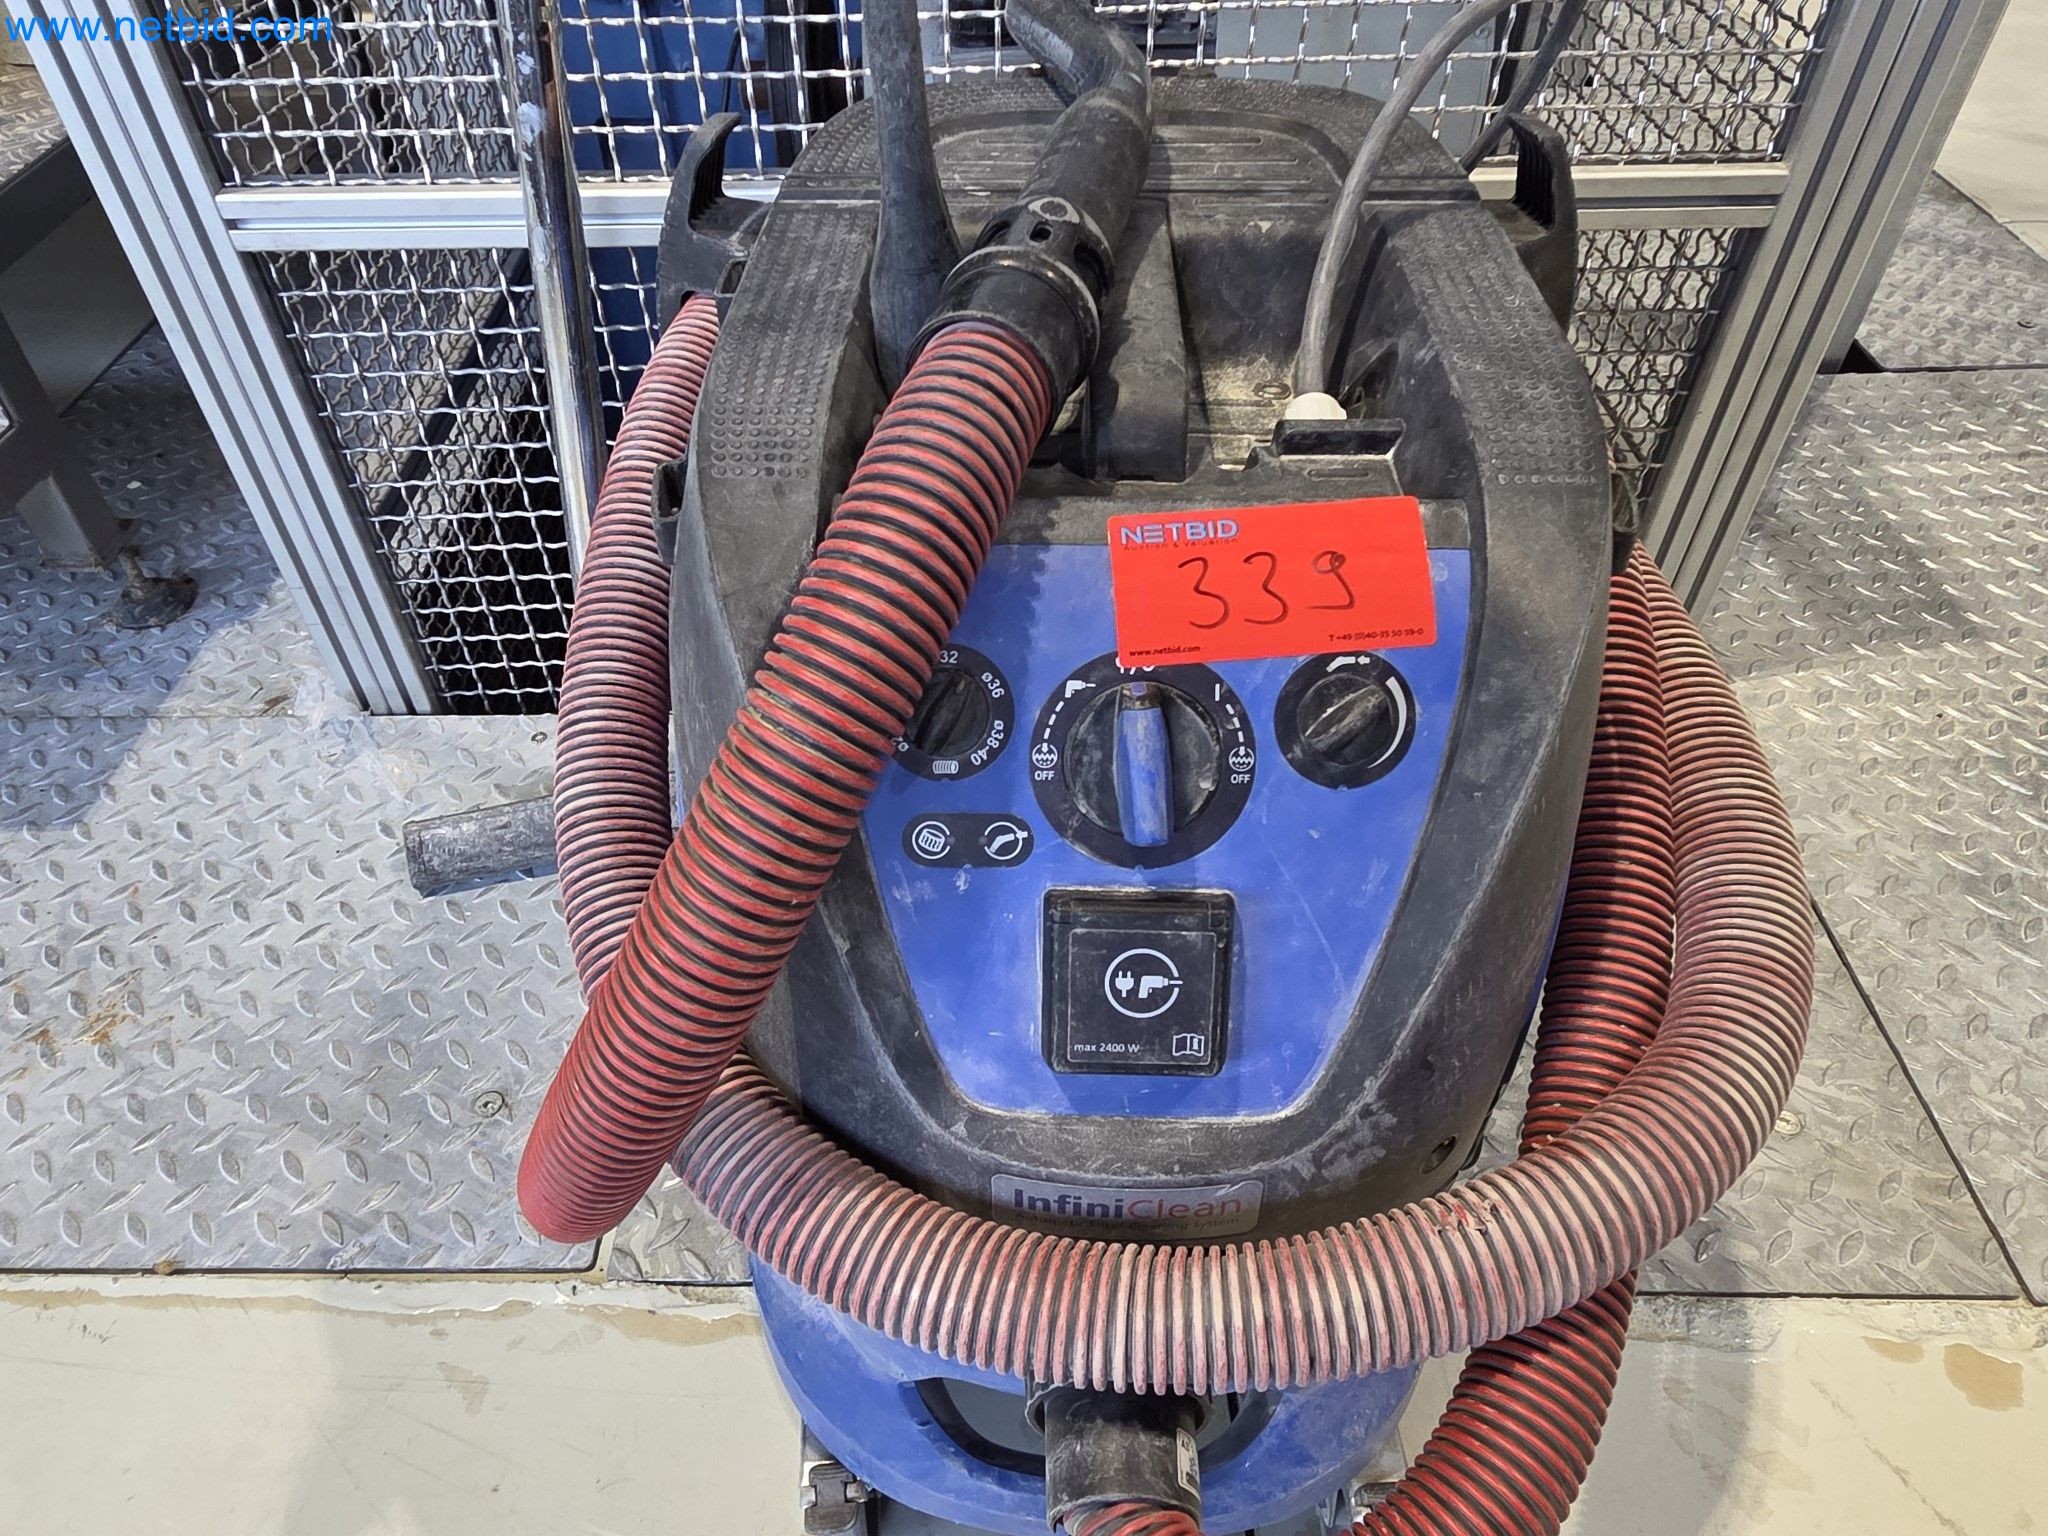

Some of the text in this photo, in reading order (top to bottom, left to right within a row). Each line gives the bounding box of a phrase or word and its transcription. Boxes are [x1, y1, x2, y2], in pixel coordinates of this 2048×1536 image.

[1121, 519, 1239, 545] NETBID
[1177, 550, 1356, 629] 339
[1129, 645, 1201, 656] www.netbid.com
[1034, 770, 1055, 781] OFF
[1230, 774, 1251, 784] OFF
[1074, 1042, 1140, 1053] max 2400 W
[1013, 1188, 1242, 1219] InfiniClean
